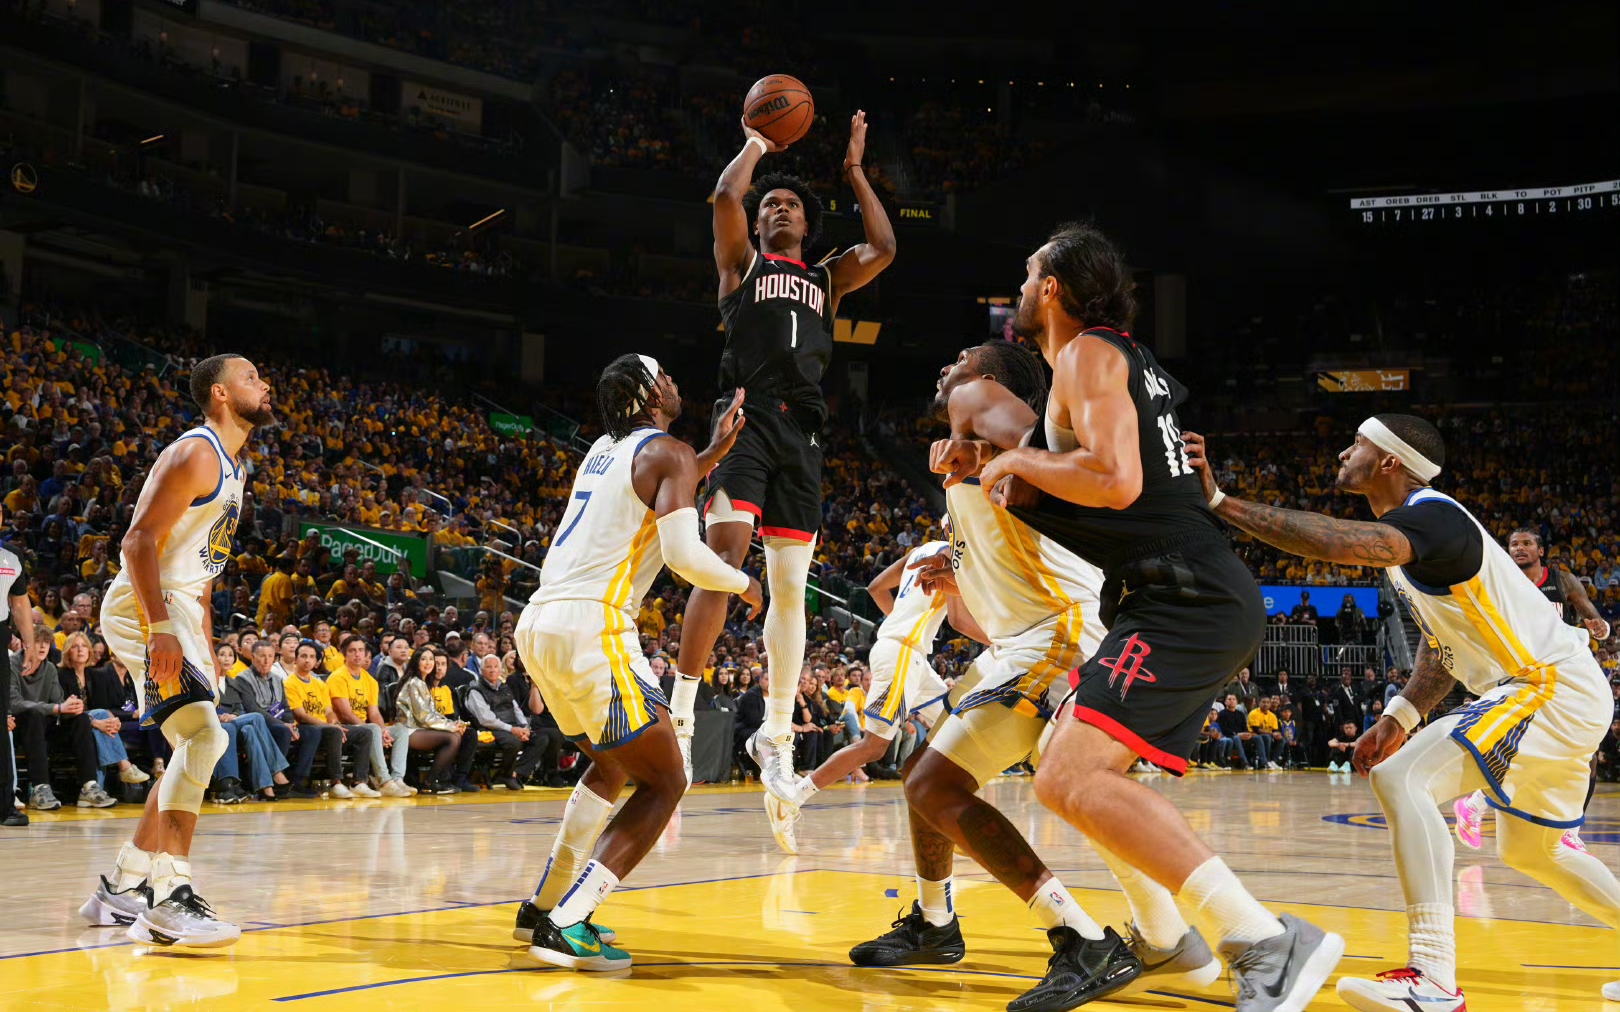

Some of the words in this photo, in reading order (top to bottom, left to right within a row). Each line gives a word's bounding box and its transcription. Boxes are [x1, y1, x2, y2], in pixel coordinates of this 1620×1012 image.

[748, 95, 791, 121] Wilson
[829, 199, 837, 211] 5
[1359, 199, 1376, 207] AST
[1385, 197, 1410, 205] OREB
[1416, 195, 1440, 204] DREB
[1450, 194, 1467, 202] STL
[1514, 190, 1528, 198] TO
[1543, 188, 1562, 197] POT
[1573, 185, 1595, 194] PITP
[900, 208, 933, 219] FINAL
[1362, 211, 1374, 223] 15
[1394, 209, 1401, 221] 7
[1421, 207, 1435, 220] 27
[1455, 205, 1462, 218] 3
[1485, 204, 1493, 217] 4
[1517, 202, 1525, 215] 8
[1549, 200, 1557, 213] 2
[1577, 197, 1592, 210] 30
[755, 273, 826, 319] HOUSTON
[790, 309, 798, 349] 1
[583, 453, 615, 476] HIELD
[555, 490, 593, 548] 7
[321, 533, 409, 568] PagerDuty
